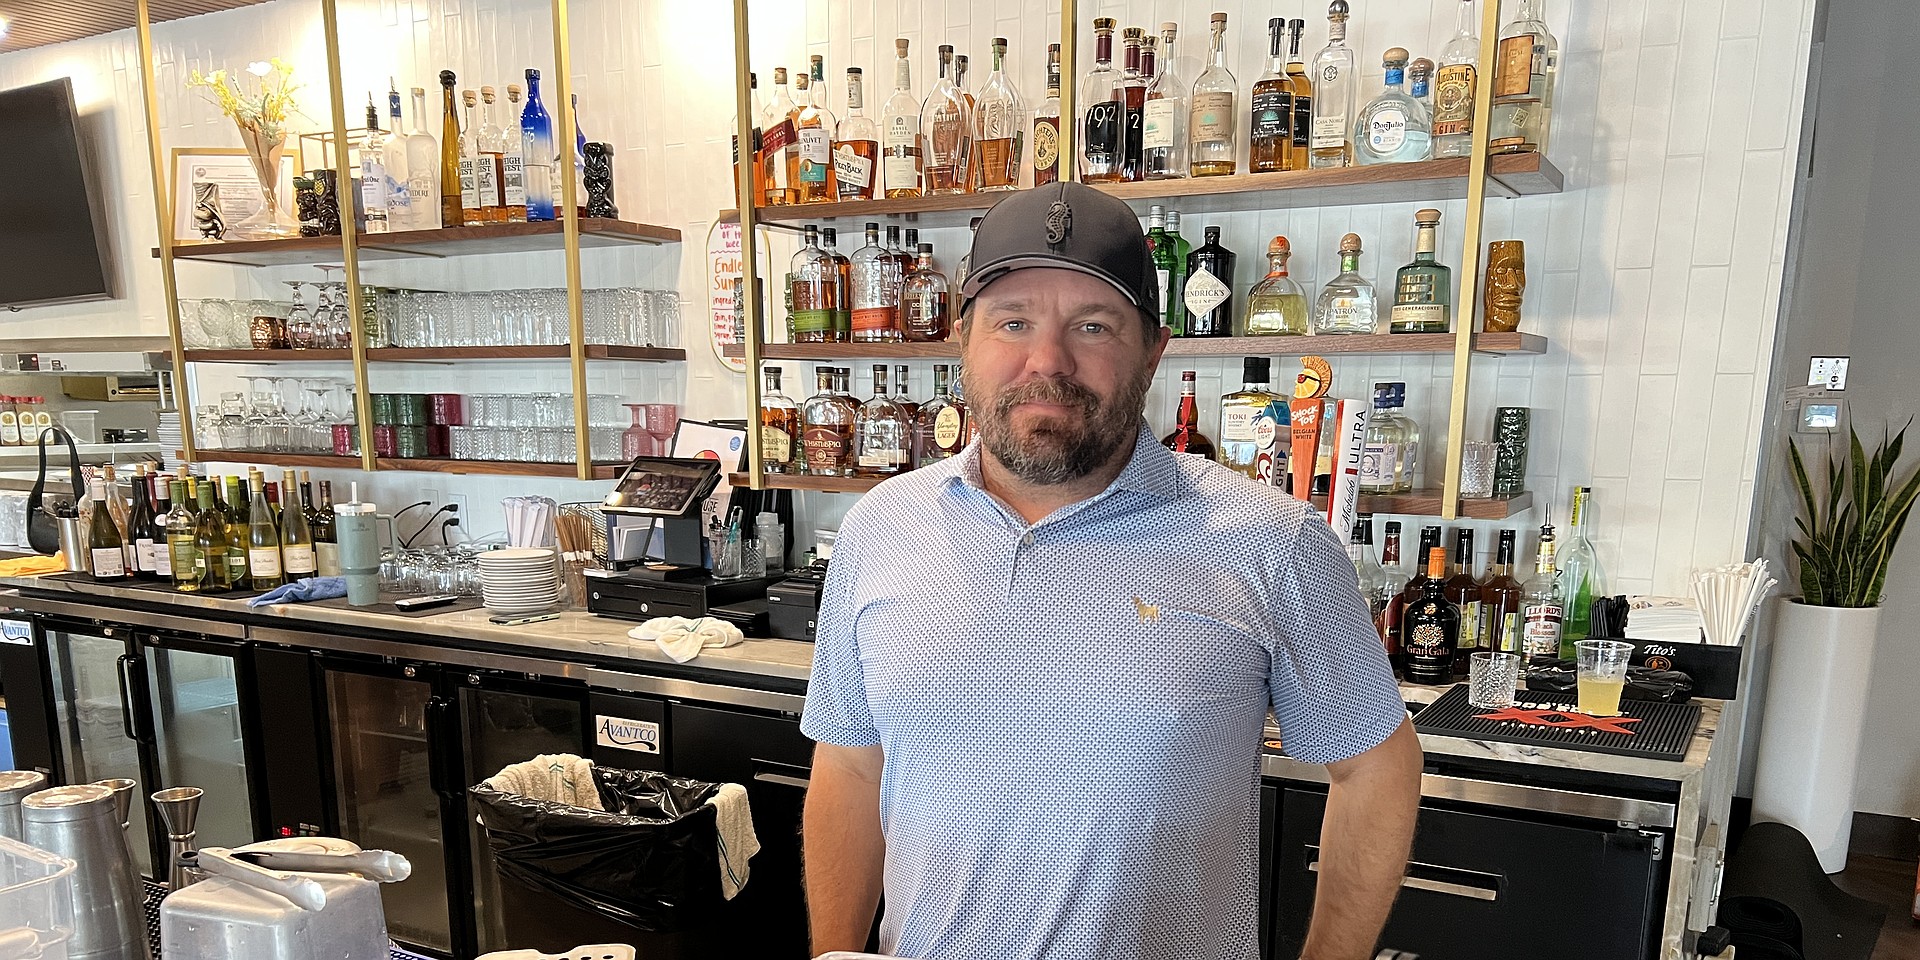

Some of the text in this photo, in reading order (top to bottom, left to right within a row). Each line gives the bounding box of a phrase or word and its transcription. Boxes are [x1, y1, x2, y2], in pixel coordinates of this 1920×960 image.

[1439, 125, 1456, 134] GIN
[715, 257, 743, 274] Endle
[1291, 405, 1319, 421] SHOCK
[1298, 414, 1315, 426] TOP
[1349, 410, 1366, 464] ULTRA
[1275, 460, 1286, 487] GHT
[1340, 478, 1356, 533] Michelob
[1643, 645, 1676, 655] Tito's
[599, 719, 656, 746] AVANTCO
